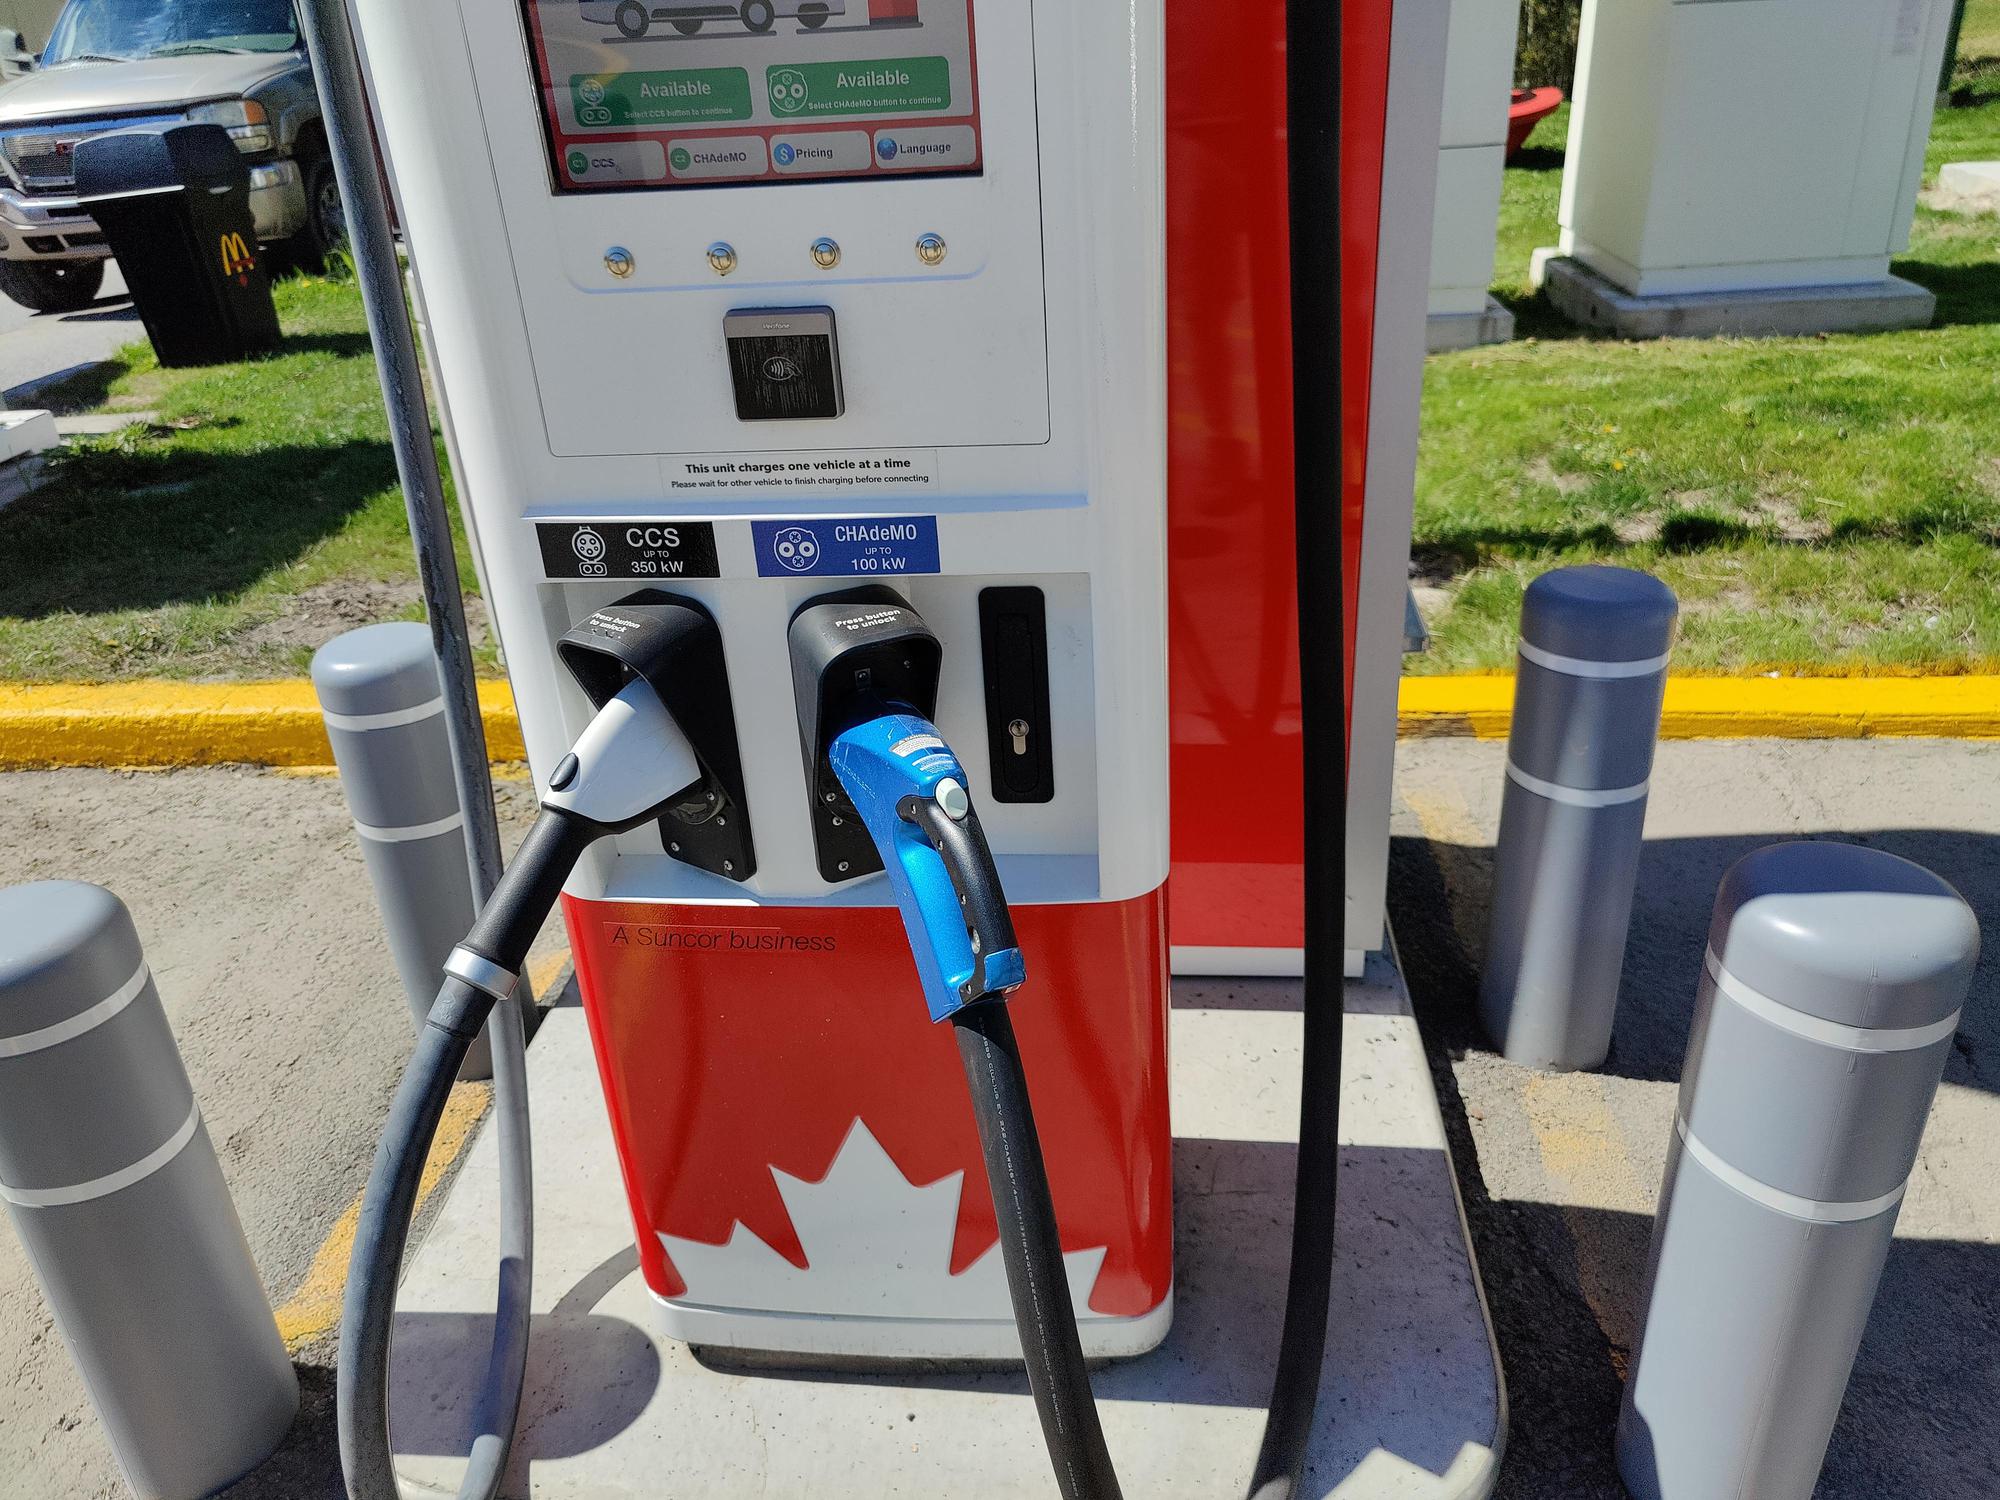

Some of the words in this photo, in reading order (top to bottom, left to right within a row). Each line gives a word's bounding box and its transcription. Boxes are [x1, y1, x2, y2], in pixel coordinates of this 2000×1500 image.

[836, 69, 910, 88] Available
[640, 81, 712, 98] Available
[808, 101, 833, 110] Select
[833, 99, 871, 109] CHAdeMO
[873, 98, 898, 107] button
[899, 97, 907, 105] to
[909, 96, 942, 105] continue
[624, 110, 648, 119] Select
[648, 110, 666, 118] CCS
[666, 109, 691, 117] button
[691, 108, 699, 116] to
[701, 106, 733, 115] continue
[795, 147, 833, 159] Pricing
[900, 142, 952, 156] Language
[591, 158, 615, 169] CCS
[693, 151, 747, 164] CHAdeMO
[685, 463, 709, 473] This
[712, 463, 735, 473] unit
[738, 462, 785, 474] charges
[788, 463, 810, 471] one
[813, 460, 855, 470] vehicle
[859, 460, 871, 469] at
[874, 461, 880, 469] a
[884, 458, 911, 468] time
[671, 480, 696, 488] Please
[698, 480, 715, 488] wait
[717, 479, 728, 487] for
[730, 479, 751, 487] other
[754, 478, 782, 486] vehicle
[795, 477, 816, 485] finish
[818, 476, 853, 485] charging
[855, 475, 882, 483] before
[884, 474, 929, 483] connecting
[625, 528, 680, 548] CCS
[835, 524, 917, 542] CHAdeMO
[643, 550, 656, 558] UP
[657, 550, 670, 558] TO
[865, 547, 877, 555] UP
[631, 561, 657, 573] 350
[661, 561, 684, 573] kW
[851, 558, 878, 571] 100
[883, 557, 906, 570] kW
[592, 613, 613, 622] Press
[613, 617, 640, 629] button
[835, 616, 864, 627] Press
[865, 609, 900, 620] button
[861, 616, 896, 628] unlock
[600, 622, 627, 632] unlock
[612, 926, 629, 945] A
[636, 928, 723, 949] Suncor
[730, 930, 836, 951] business
